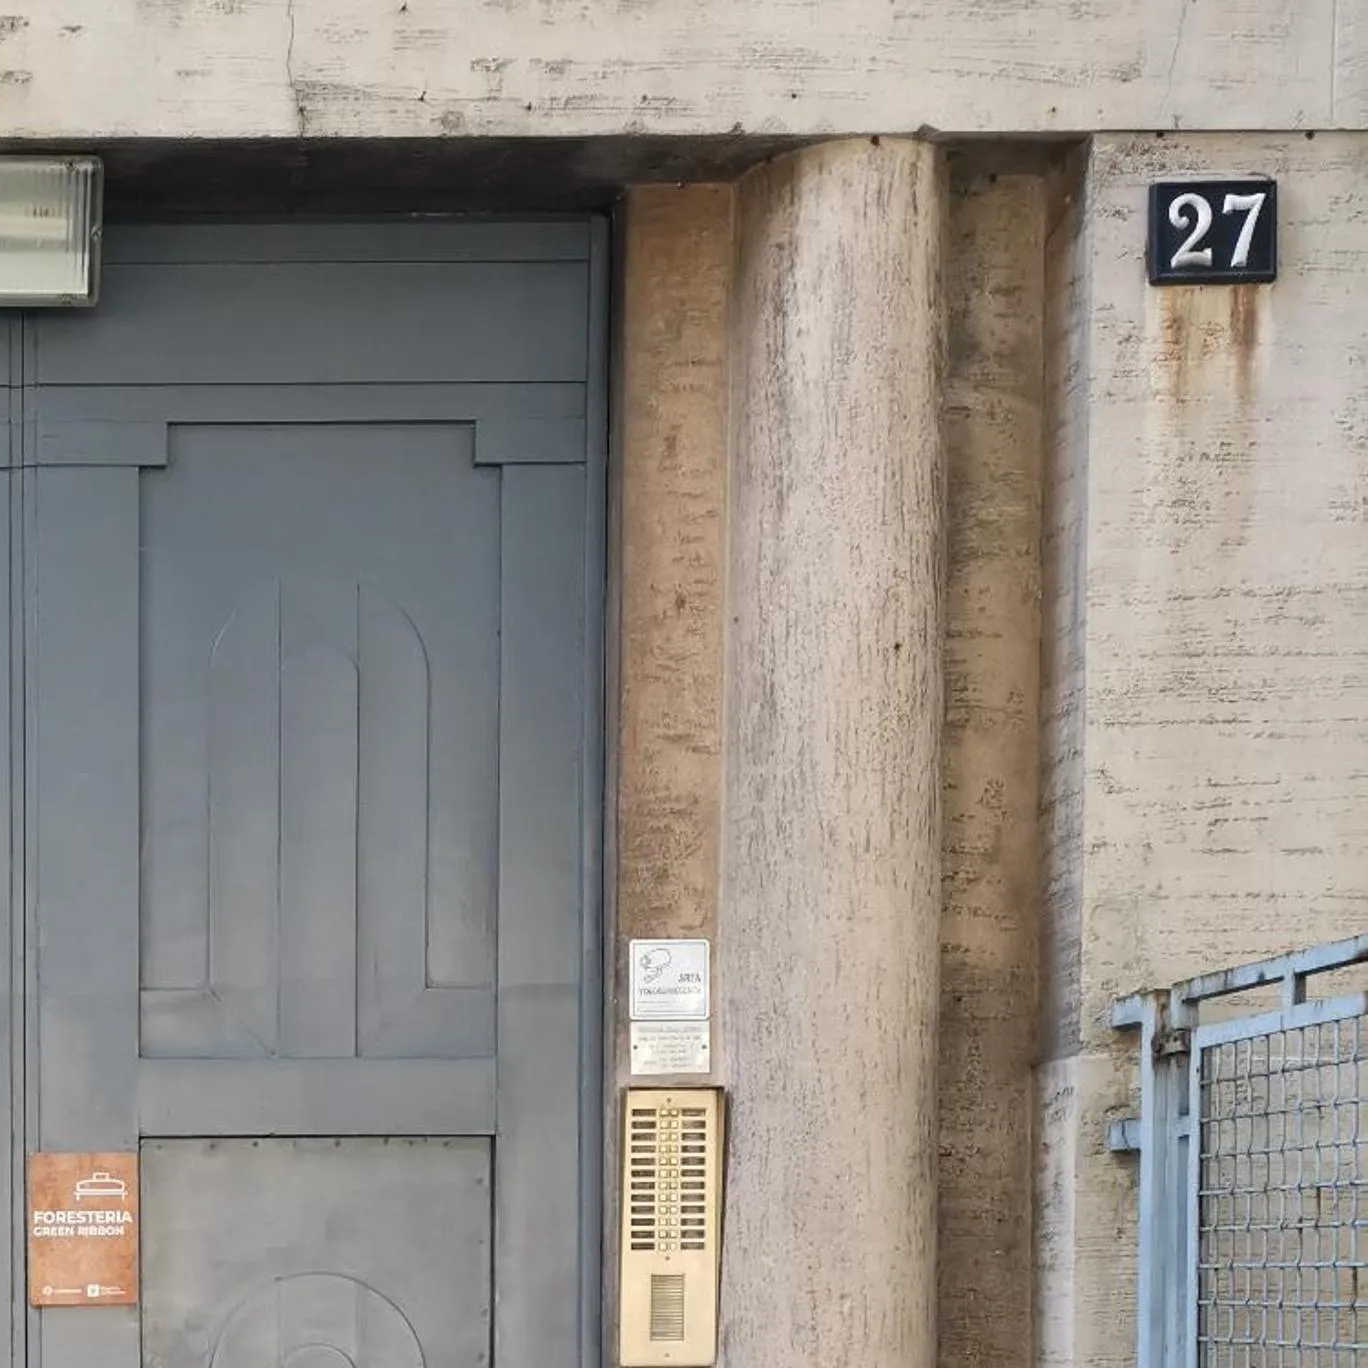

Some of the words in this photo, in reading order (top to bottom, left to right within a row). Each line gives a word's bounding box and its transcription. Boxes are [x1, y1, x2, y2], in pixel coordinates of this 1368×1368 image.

[1168, 192, 1267, 269] 27
[34, 1210, 133, 1224] FORESTERIA
[33, 1226, 74, 1236] GREEN
[78, 1225, 125, 1236] RIBBON
